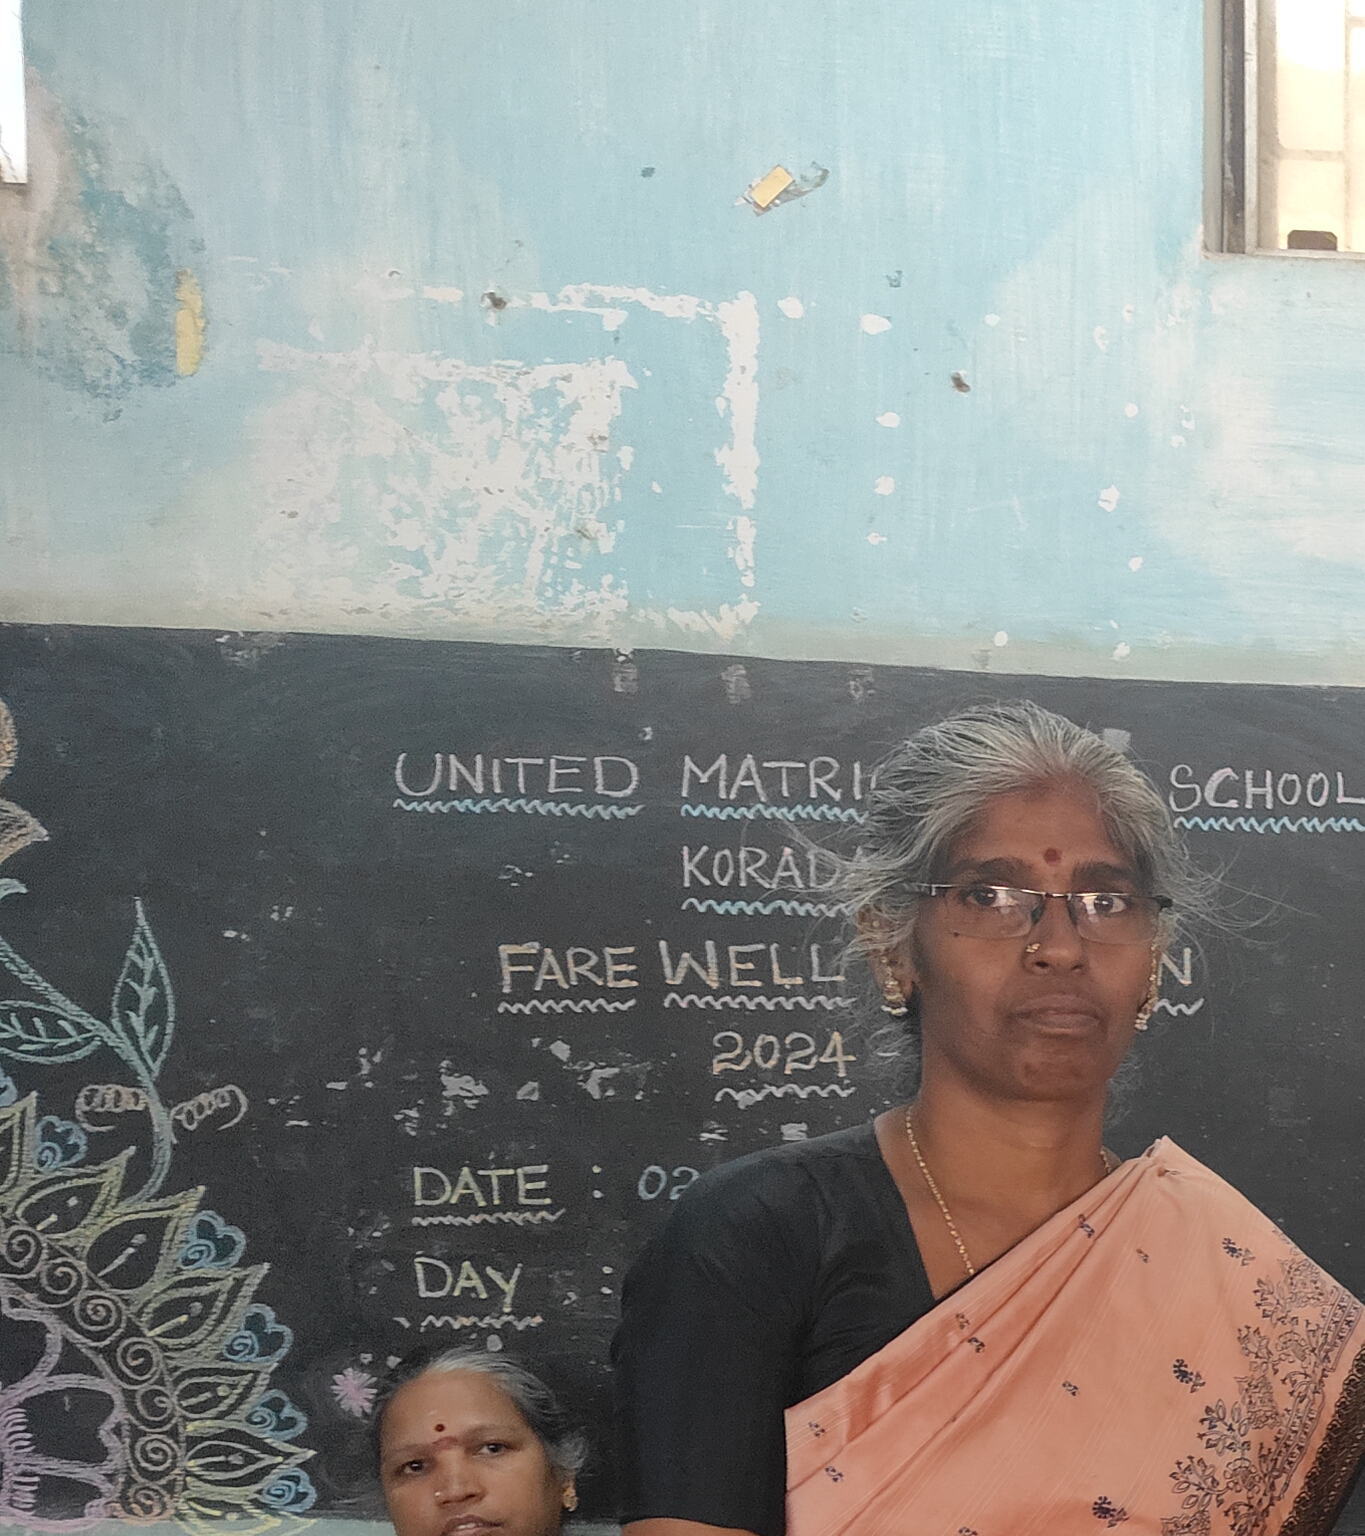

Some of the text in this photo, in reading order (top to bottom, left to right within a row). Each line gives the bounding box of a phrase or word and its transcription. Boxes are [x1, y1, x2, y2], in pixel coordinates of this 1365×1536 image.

[394, 752, 639, 798] UNITED
[681, 753, 878, 801] MATRI
[682, 845, 865, 888] KORAD
[499, 940, 846, 993] FARE WELL
[713, 1031, 856, 1077] 2024
[414, 1165, 552, 1206] DATE
[414, 1257, 522, 1313] DAY
